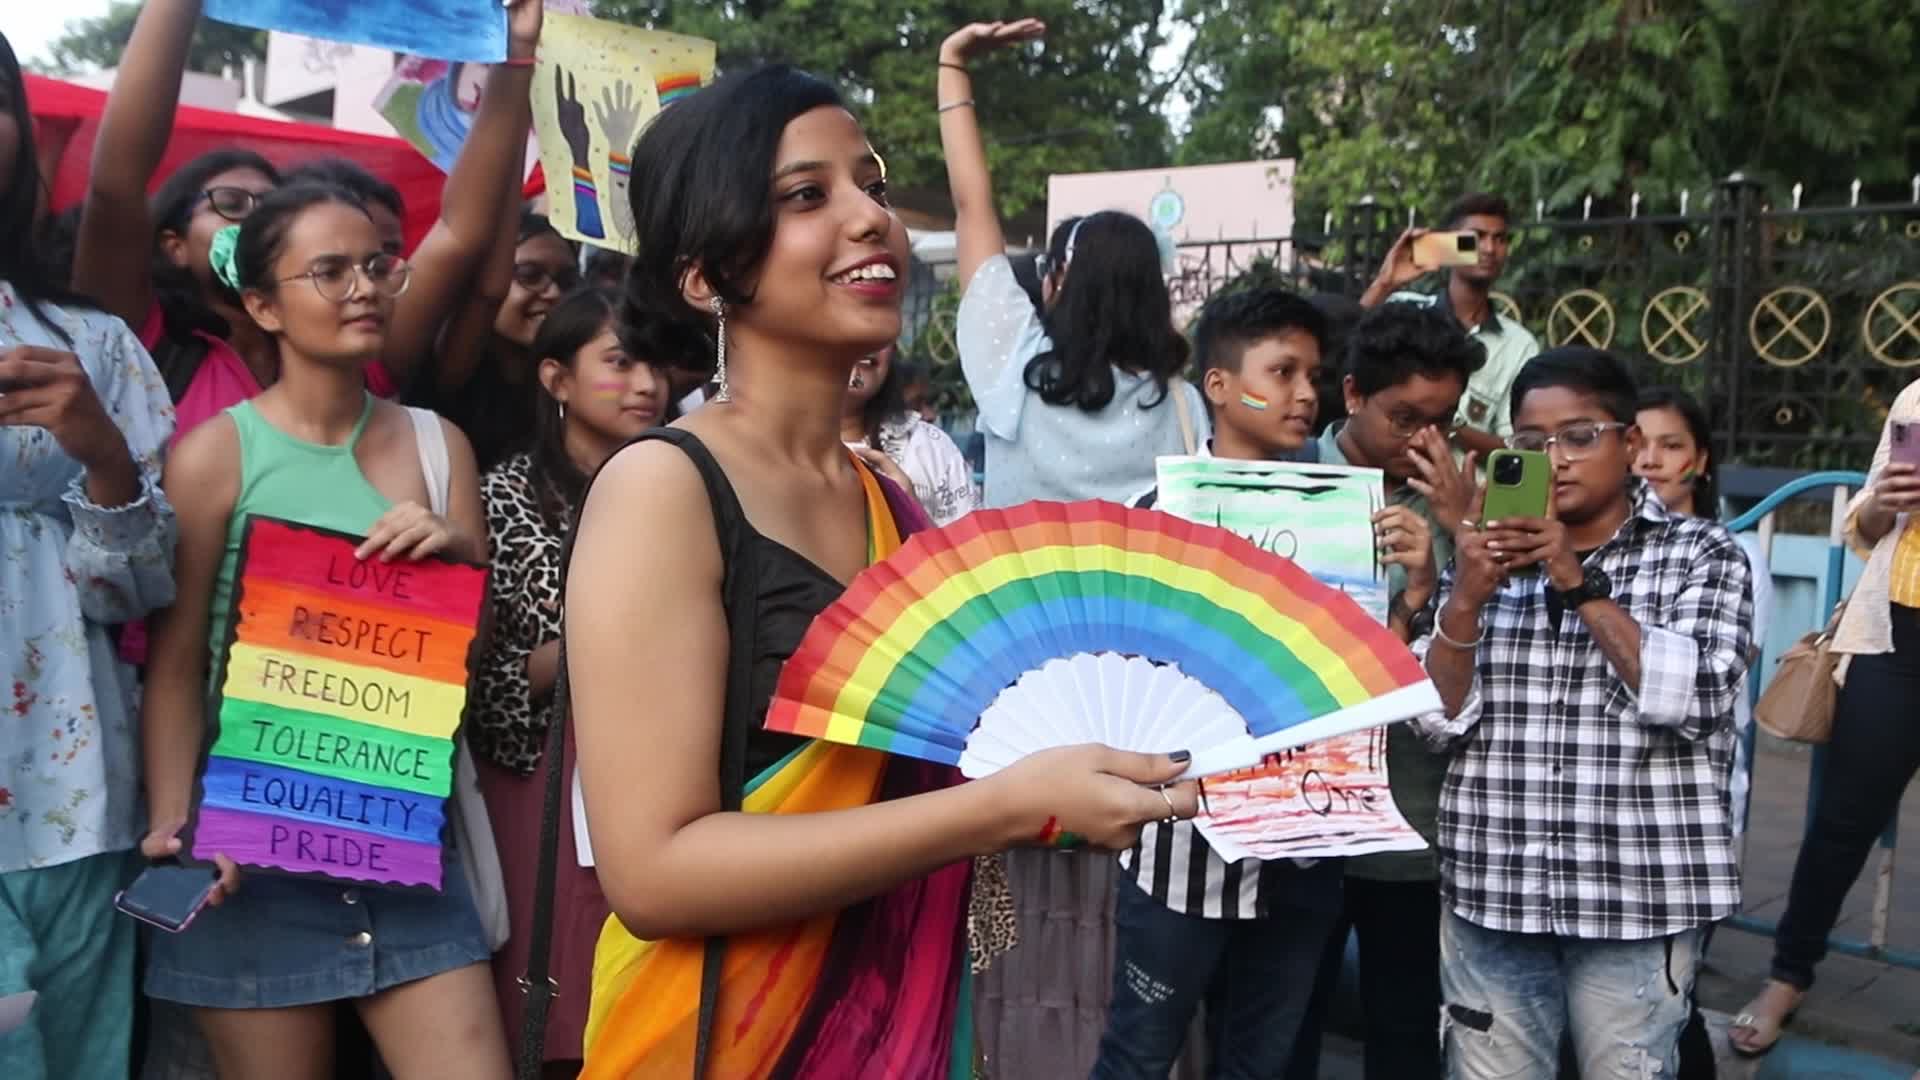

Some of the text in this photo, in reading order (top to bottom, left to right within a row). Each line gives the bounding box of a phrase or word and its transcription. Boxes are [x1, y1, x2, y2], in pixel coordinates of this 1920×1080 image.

[327, 557, 412, 599] LOVE
[290, 606, 432, 662] RESPECT
[262, 659, 410, 718] FREEDOM
[253, 720, 430, 780] TOLERANCE
[243, 774, 418, 831] EQUALITY
[271, 825, 389, 872] PRIDE
